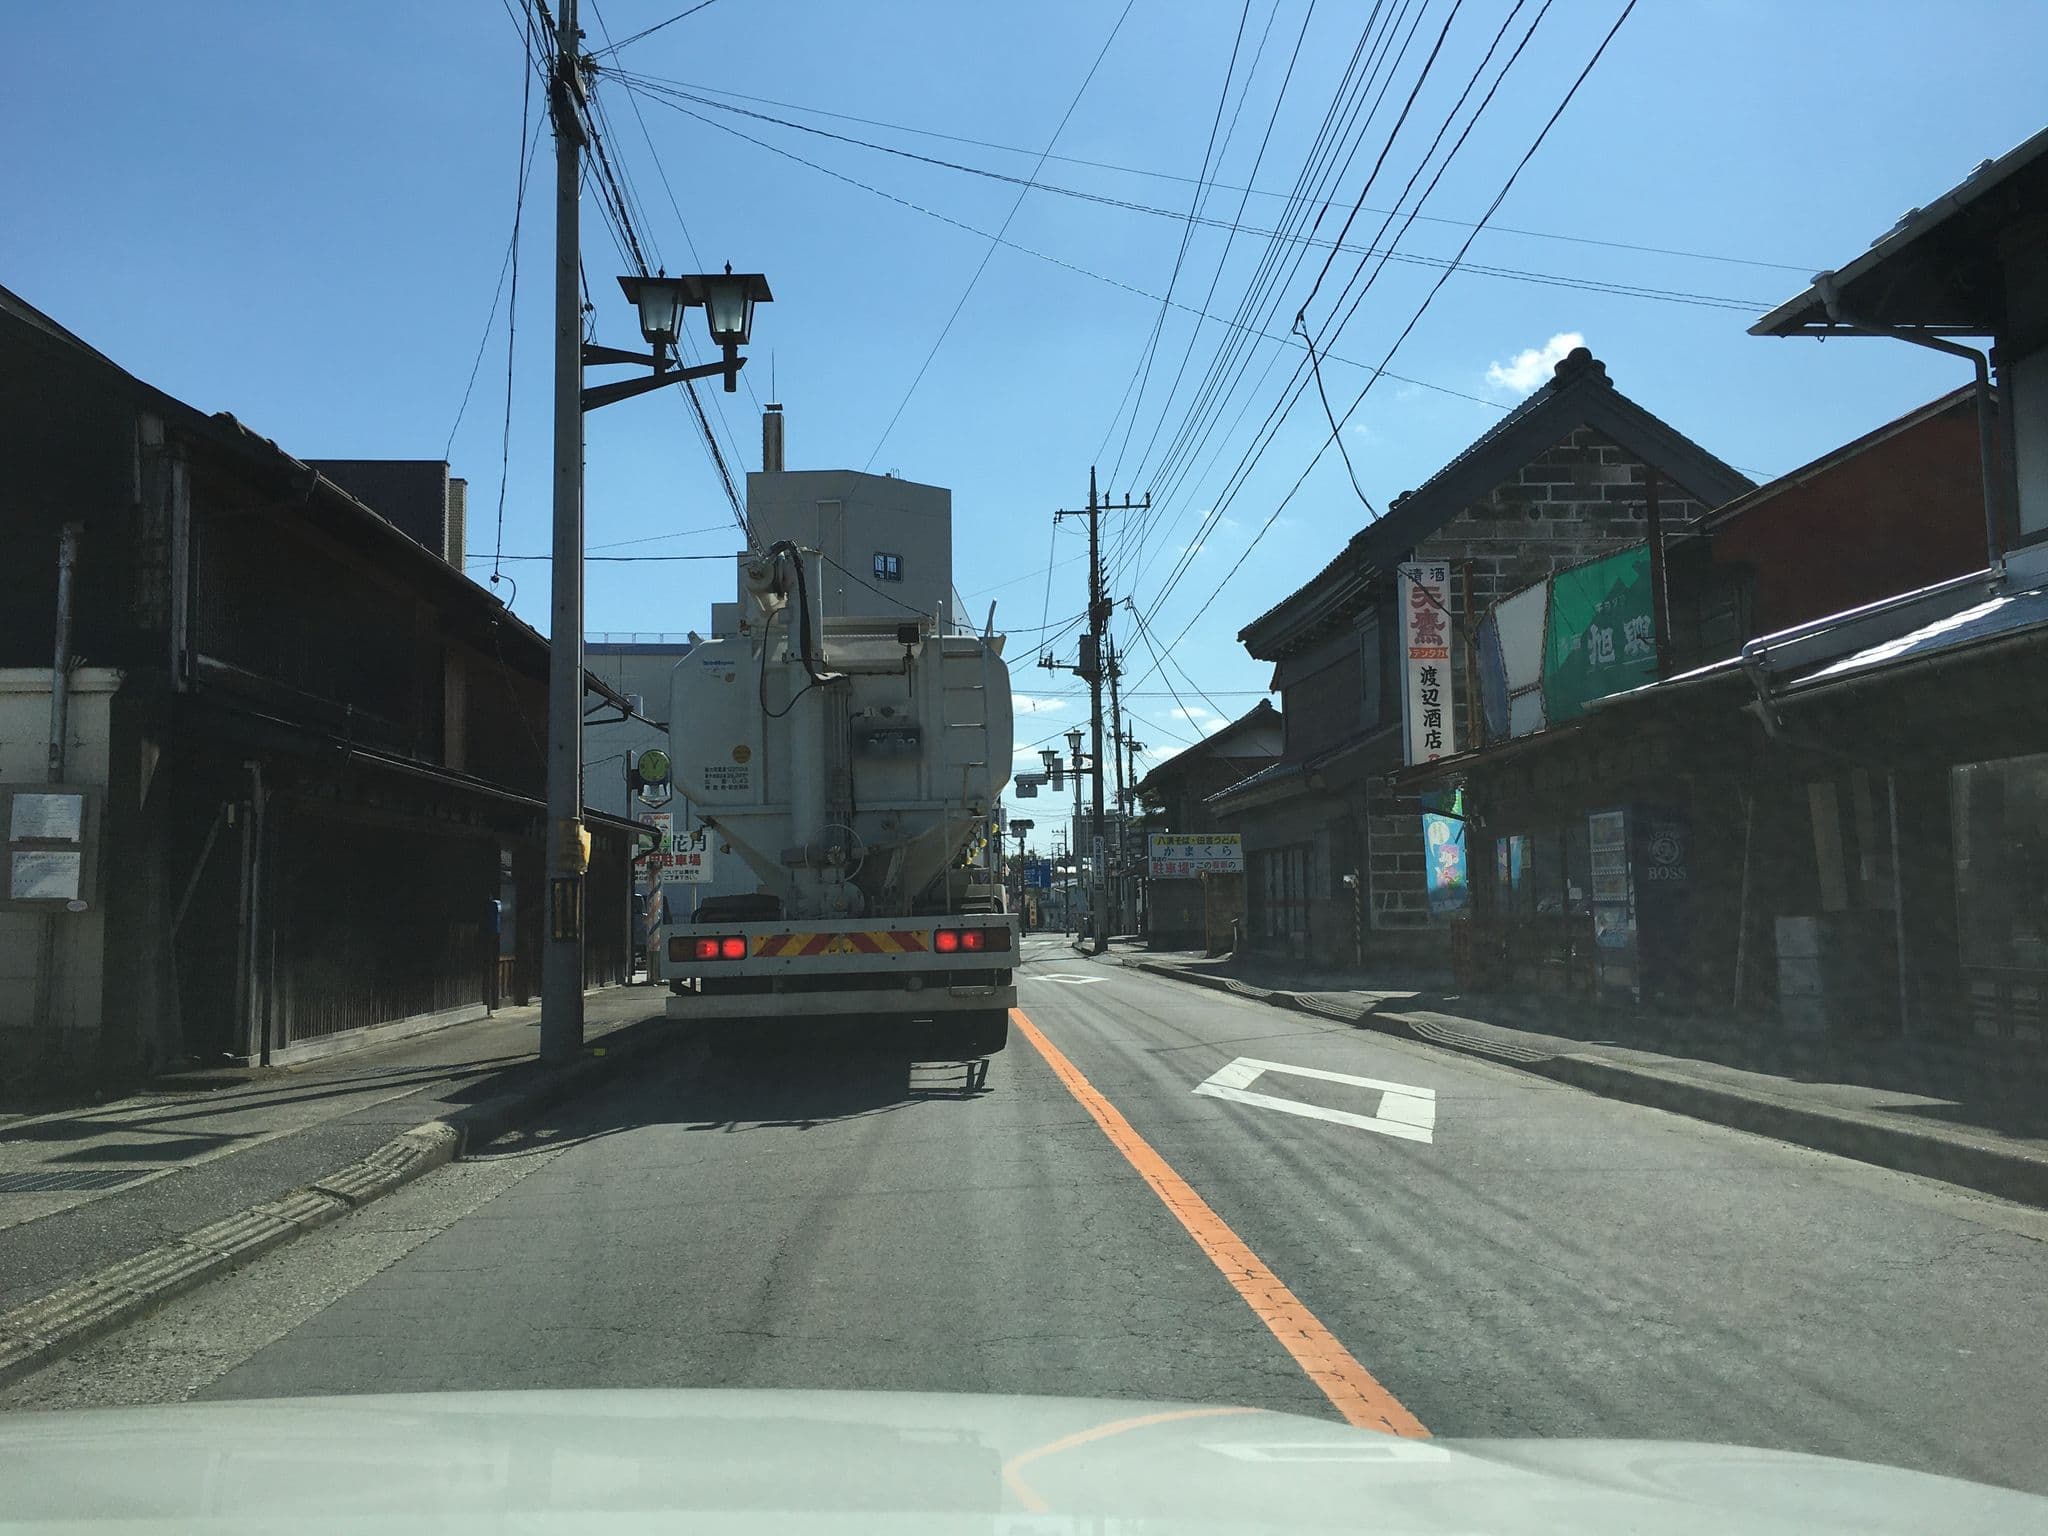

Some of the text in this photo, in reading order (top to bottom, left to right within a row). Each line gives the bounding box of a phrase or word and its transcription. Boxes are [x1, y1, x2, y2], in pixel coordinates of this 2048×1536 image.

[1409, 568, 1444, 581] 清酒
[1420, 665, 1442, 749] 渡辺酒店
[1163, 845, 1232, 857] かまくら
[1648, 866, 1687, 880] BOSS
